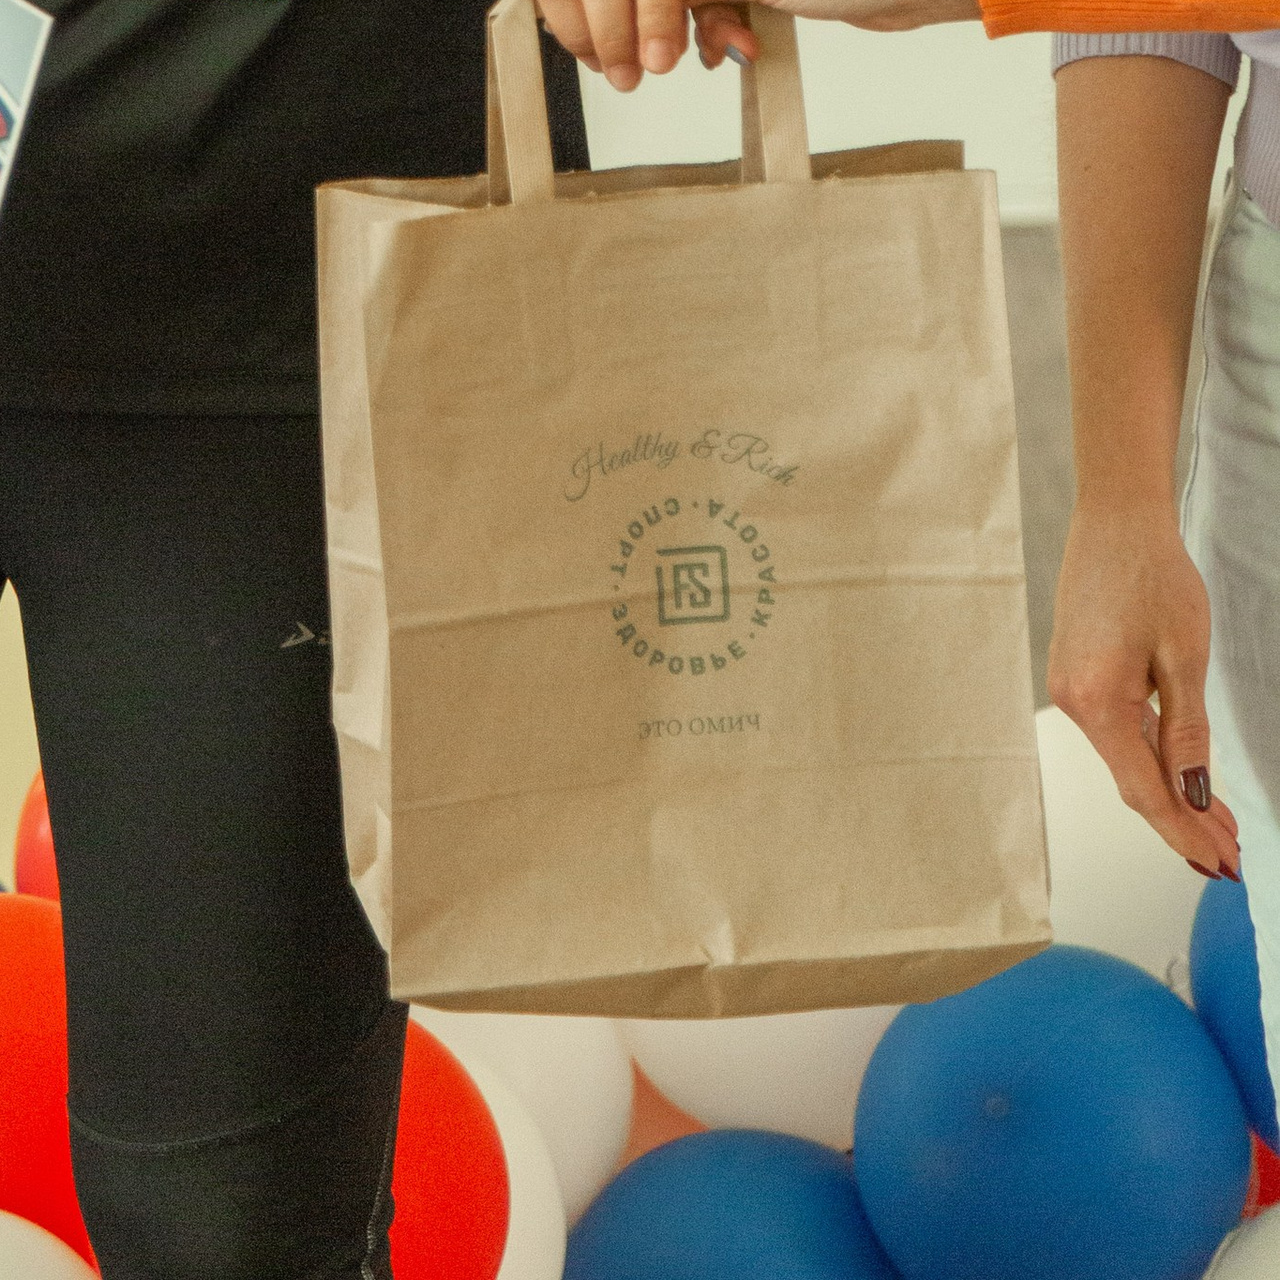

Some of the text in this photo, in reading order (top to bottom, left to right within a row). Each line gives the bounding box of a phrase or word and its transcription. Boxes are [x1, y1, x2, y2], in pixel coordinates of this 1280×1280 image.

[564, 429, 800, 502] Healthy & Rich
[610, 497, 680, 578] СПОРТ
[708, 498, 778, 627] КРАСОТА
[612, 602, 747, 676] ЗДОРОВЬЕ
[638, 718, 683, 741] ЭТО
